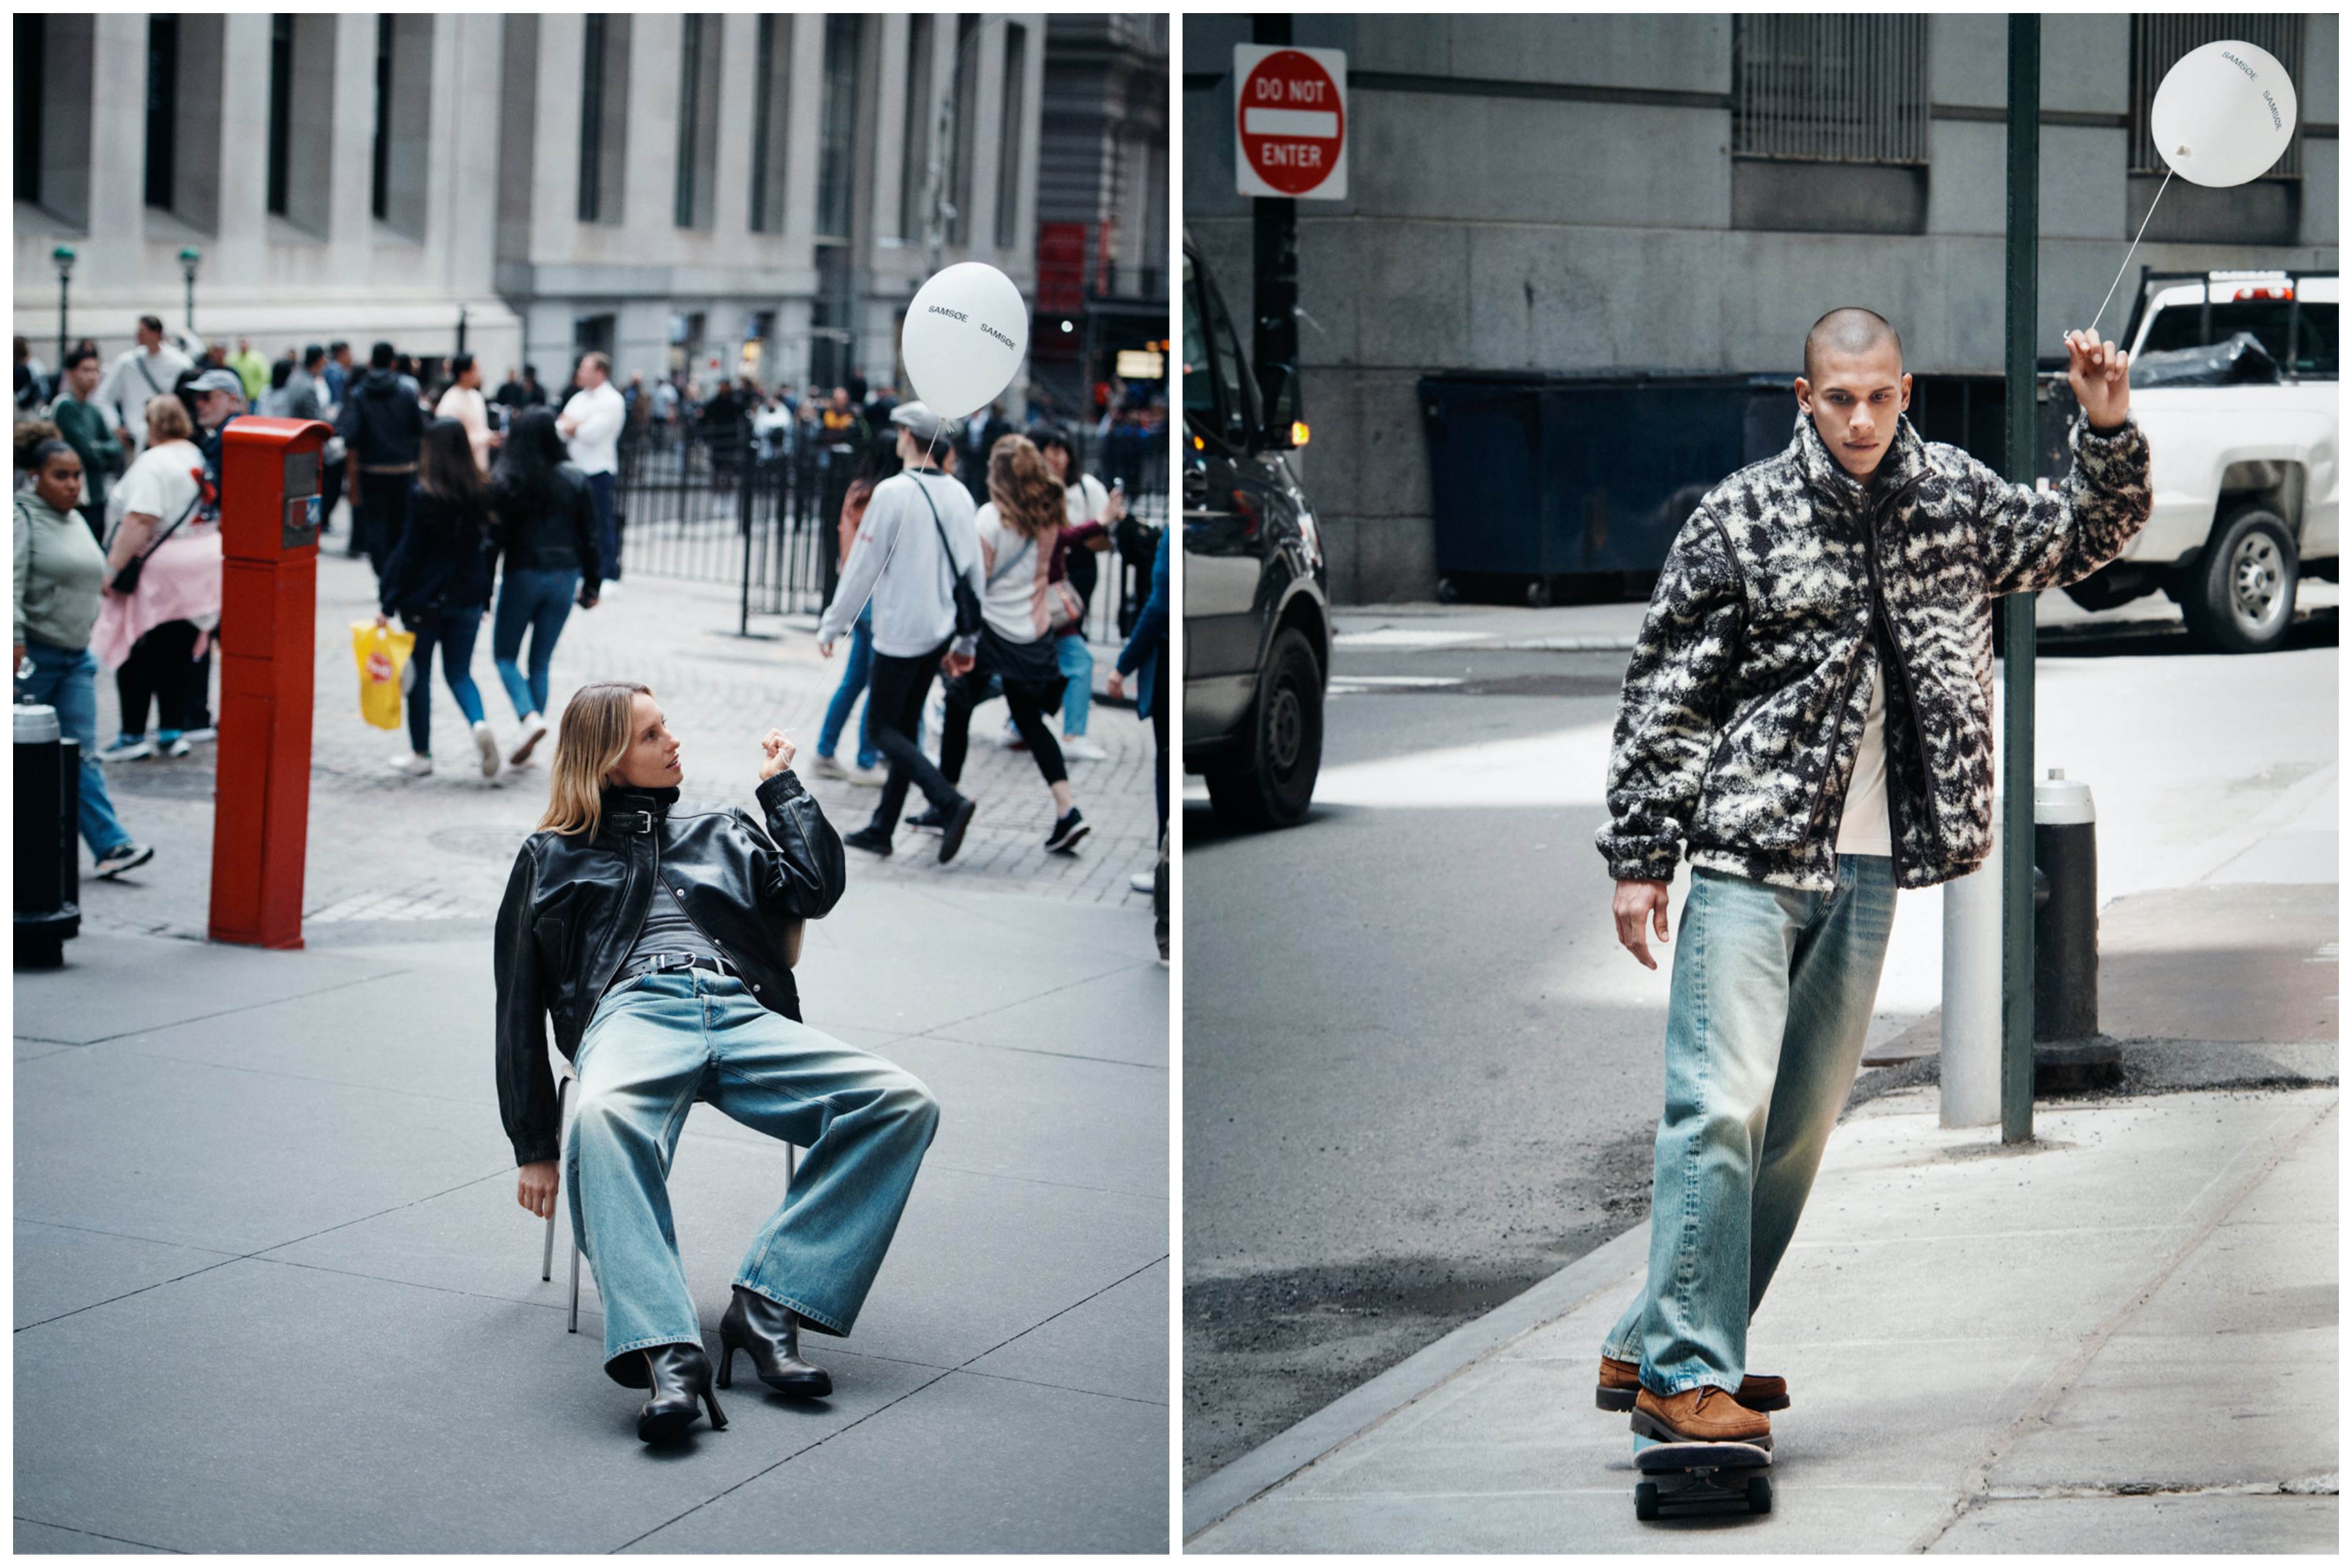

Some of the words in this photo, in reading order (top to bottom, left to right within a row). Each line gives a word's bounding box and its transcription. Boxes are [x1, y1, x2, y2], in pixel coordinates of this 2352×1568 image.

[1256, 77, 1283, 101] DO
[1289, 80, 1325, 103] NOT
[1262, 143, 1321, 167] ENTER
[928, 305, 968, 323] SAMSØE
[980, 323, 1016, 350] SAMSØE
